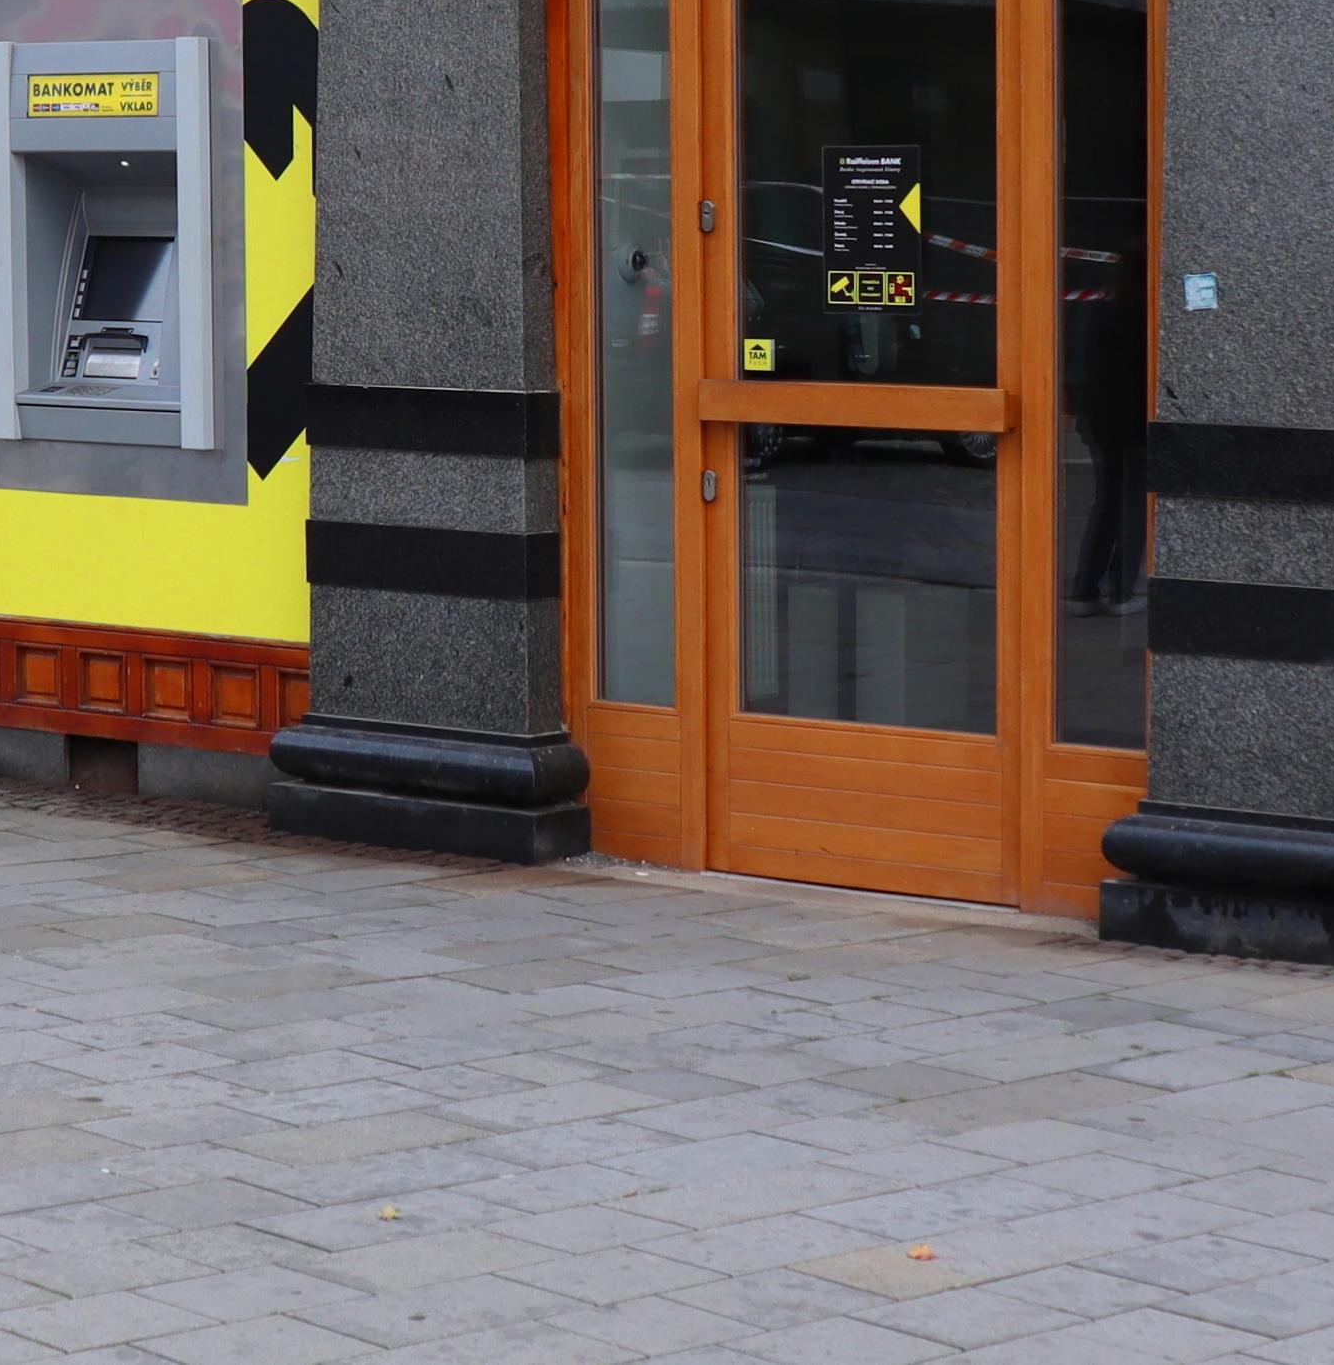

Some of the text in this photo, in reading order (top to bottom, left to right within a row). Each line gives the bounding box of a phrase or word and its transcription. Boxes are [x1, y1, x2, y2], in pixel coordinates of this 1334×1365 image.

[32, 82, 115, 97] BANKOMAT
[120, 78, 153, 92] VÝBĚR
[120, 101, 154, 112] VKLAD
[748, 351, 767, 360] TAM
